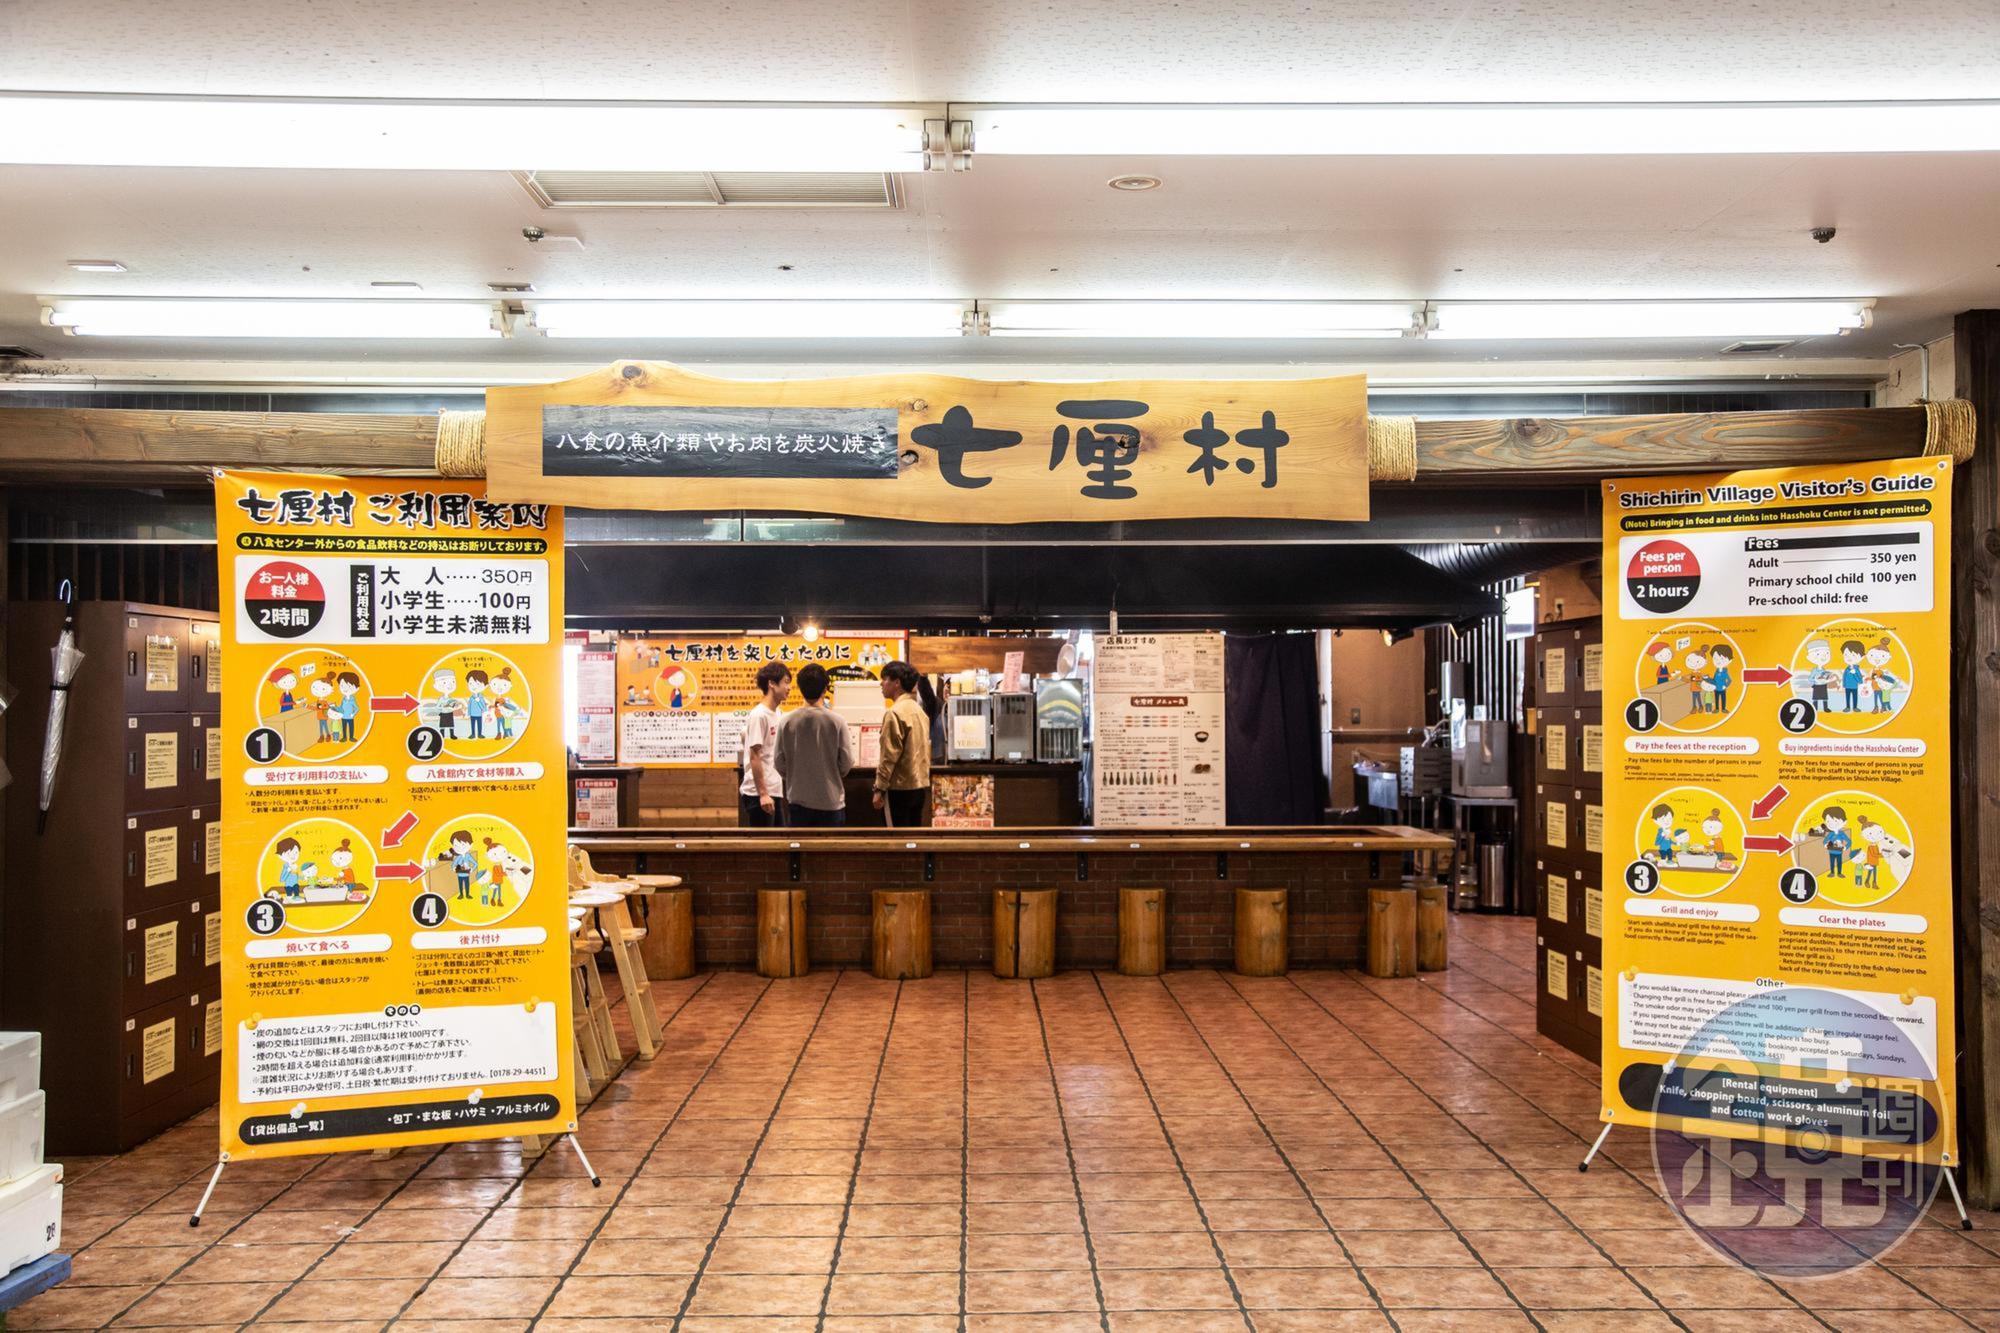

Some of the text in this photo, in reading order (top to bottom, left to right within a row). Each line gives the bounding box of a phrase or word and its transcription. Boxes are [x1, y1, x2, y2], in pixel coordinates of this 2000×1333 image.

[556, 432, 886, 455] 八食の魚介類やお肉を炭火焼き
[911, 400, 1290, 500] 七厘村
[1621, 474, 1934, 505] Shichirin Village Visitor's Guide
[237, 489, 355, 527] 七厘村
[1625, 503, 1929, 529] (Note) Bringing in food and drinks into Hasshoku Center is not permitted.
[1748, 538, 1779, 550] Fees
[1640, 552, 1686, 563] Fees per
[1748, 558, 1779, 568] Adult
[1871, 552, 1917, 564] 350 yen
[259, 570, 309, 585] お一人様
[1644, 564, 1682, 574] person
[1871, 572, 1917, 583] 100 yen
[1749, 573, 1864, 588] Primary school child
[271, 584, 298, 598] 料金
[1637, 583, 1689, 598] 2 hours
[1749, 592, 1869, 607] Pre-school child: free
[356, 572, 370, 631] ご利用料金
[380, 590, 444, 610] 小学生
[260, 608, 310, 626] 2時間
[380, 615, 532, 635] 小学生未満無料
[665, 643, 851, 662] 七厘村を楽しむために
[1635, 703, 1647, 728] 1
[1789, 703, 1805, 729] 2
[256, 733, 269, 759] 1
[417, 731, 433, 757] 2
[1636, 742, 1649, 750] Pay
[1708, 743, 1747, 752] reception
[1797, 744, 1832, 752] ingredients
[1634, 865, 1649, 891] 3
[1789, 873, 1807, 899] 4
[257, 904, 274, 931] 3
[421, 897, 438, 923] 4
[1679, 906, 1694, 914] and
[1695, 909, 1719, 917] enjoy
[1819, 915, 1886, 928] Clear the plates
[286, 940, 349, 953] 焼いて食べる
[459, 934, 500, 945] 後片付け
[1756, 978, 1785, 987] Other
[1723, 1078, 1818, 1099] [Rental equipment]
[1660, 1085, 1890, 1119] Knife, chopping board, scissors, aluminum foil
[1712, 1106, 1828, 1128] and cotton work gloves
[250, 1120, 324, 1136] 【貸出備品一覧】
